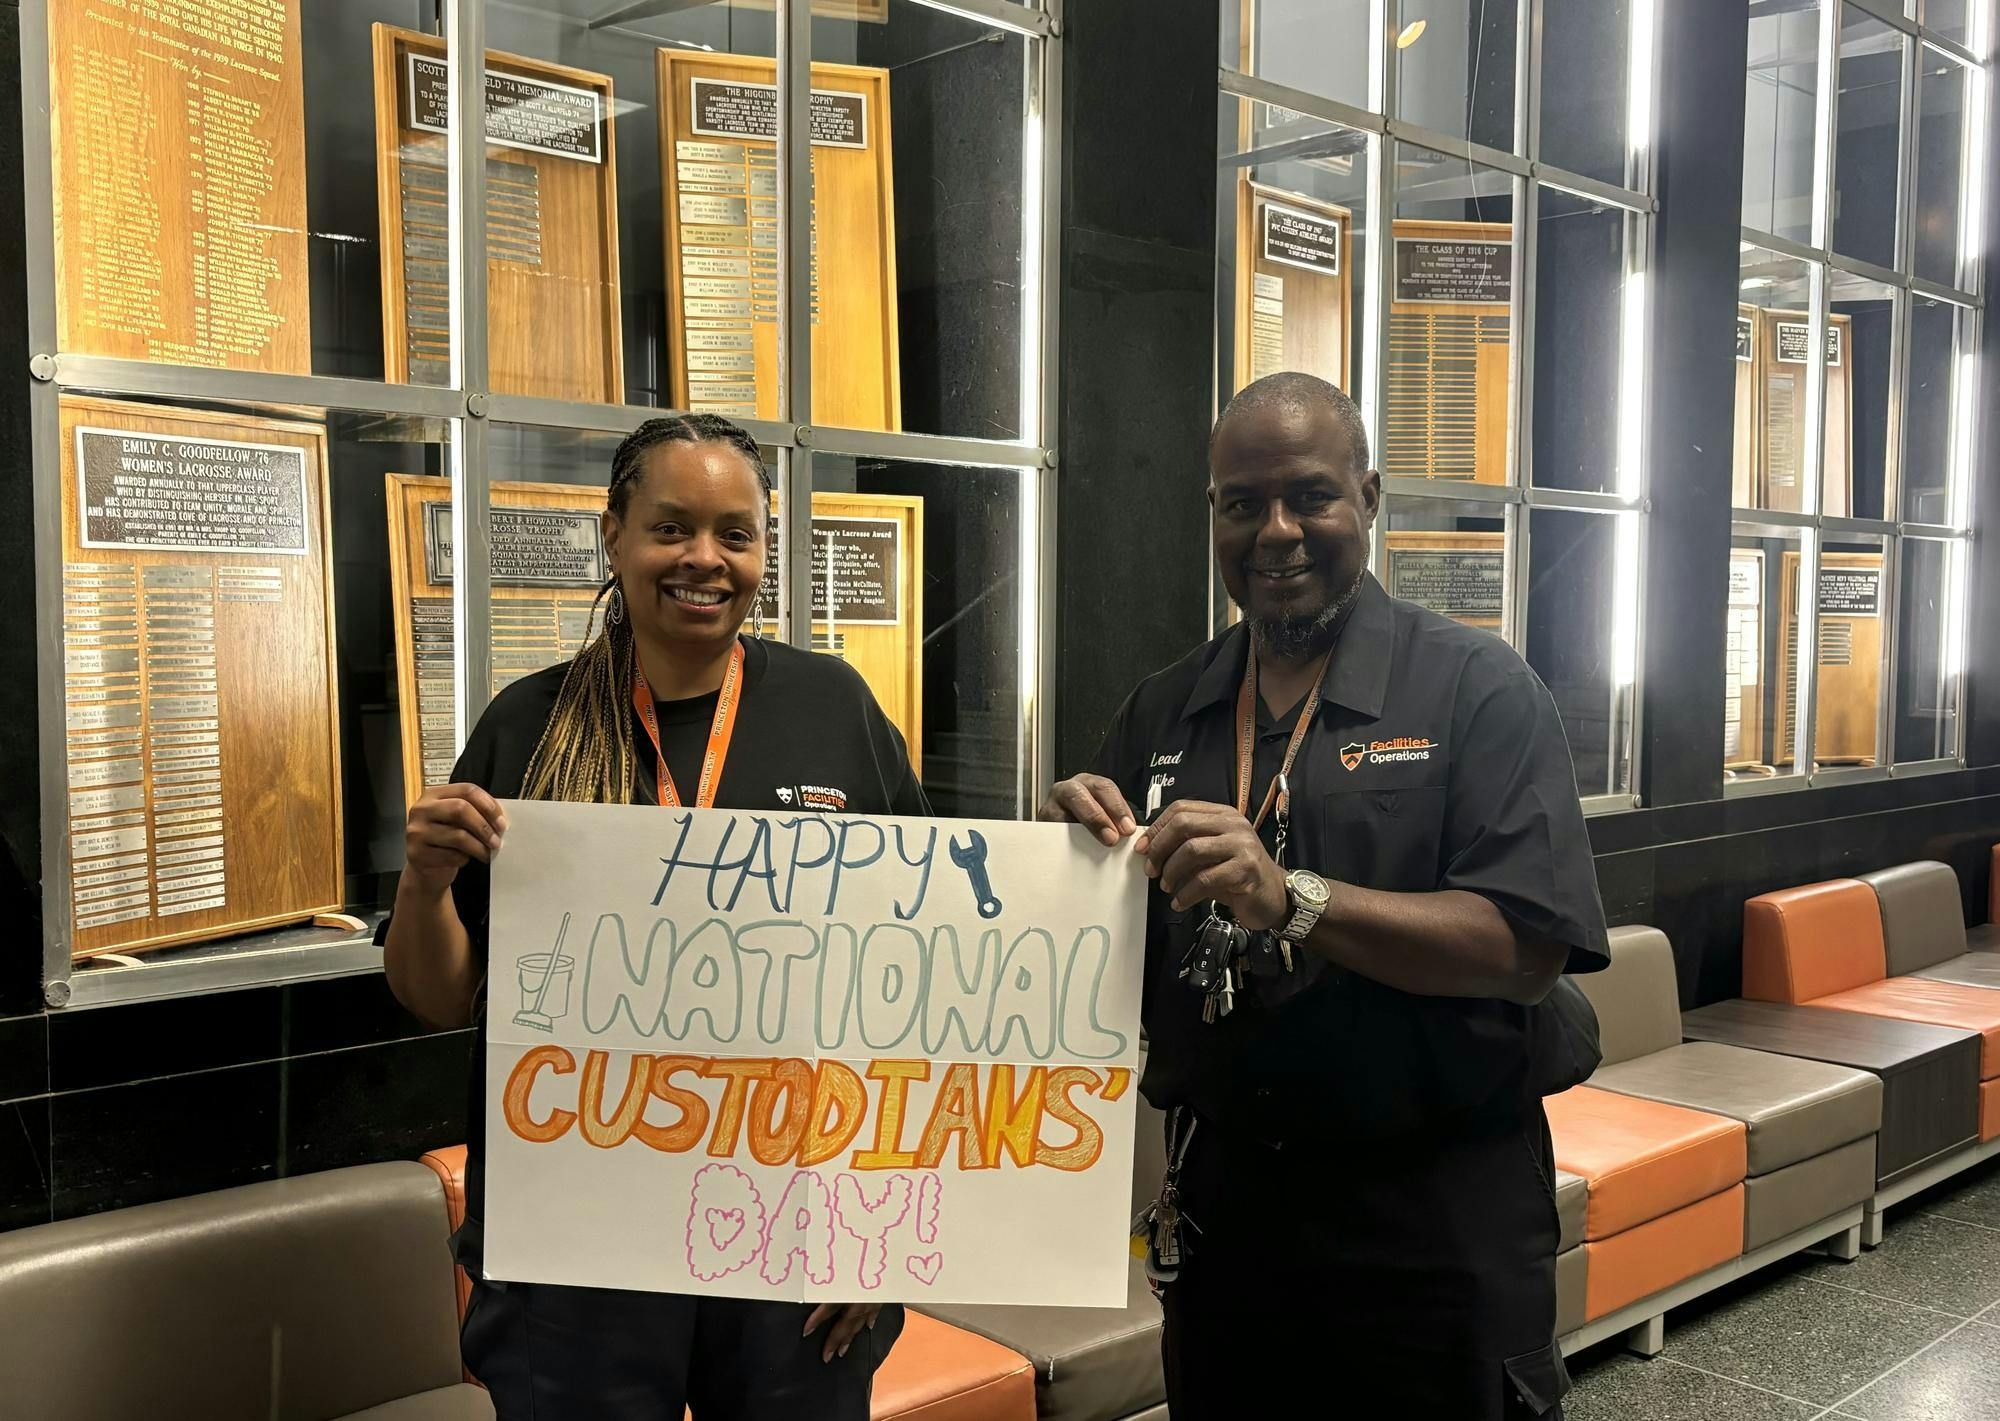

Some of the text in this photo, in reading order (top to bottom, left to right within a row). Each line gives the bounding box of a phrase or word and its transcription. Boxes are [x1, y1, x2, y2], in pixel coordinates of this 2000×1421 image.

[272, 11, 285, 22] AND
[130, 3, 283, 63] OF THE ROYAL CANADIAN AIR FORCE IN 1940.
[163, 4, 281, 52] WHO GAVE HIS LIFE WHILE SERVING
[240, 21, 247, 30] OF
[250, 24, 282, 42] PRINCETON
[85, 8, 122, 29] Presented
[152, 30, 188, 51] Teammates
[191, 44, 198, 55] of
[200, 47, 210, 59] the
[214, 52, 227, 65] 1939
[230, 57, 256, 74] Lacrosse
[417, 63, 591, 107] SCOTT '74 MEMORIAL AWARD
[725, 87, 740, 96] THE
[809, 95, 833, 104] ROPHY
[122, 439, 268, 464] EMILY C. GOODFELLOW '76
[122, 457, 271, 482] WOMEN'S LACROSSE AWARD
[113, 475, 279, 495] AWARDED ANNUALLY TO THAT UPPERCLASS PLAYER
[104, 496, 119, 506] HAS
[122, 497, 169, 509] CONTRIBUTED
[171, 500, 181, 510] TO
[184, 501, 200, 511] TEAM
[227, 504, 251, 514] MORALE
[254, 505, 266, 514] AND
[116, 486, 278, 505] WHO BY DISTINGUISHING HERSELF IN THE SPORT
[88, 506, 300, 526] AND HAS DEMONSTRATED LOVE OF LACROSSE AND OF PRINCETON
[525, 516, 564, 526] HOWARD
[492, 524, 564, 535] ROSSE TROPHY
[513, 536, 556, 545] ANNUALLY
[714, 655, 739, 736] PRINCETON UNIVERSITY
[1370, 738, 1430, 750] Facilities
[1150, 750, 1183, 768] Lead
[1370, 750, 1430, 764] Operations
[800, 785, 847, 801] PRINCETON
[803, 794, 845, 808] FACILITIES
[652, 811, 938, 920] HAPPY
[582, 913, 1128, 1060] NATIONAL
[501, 1044, 1131, 1171] CUSTODIANS'
[686, 1162, 944, 1289] DAY!
